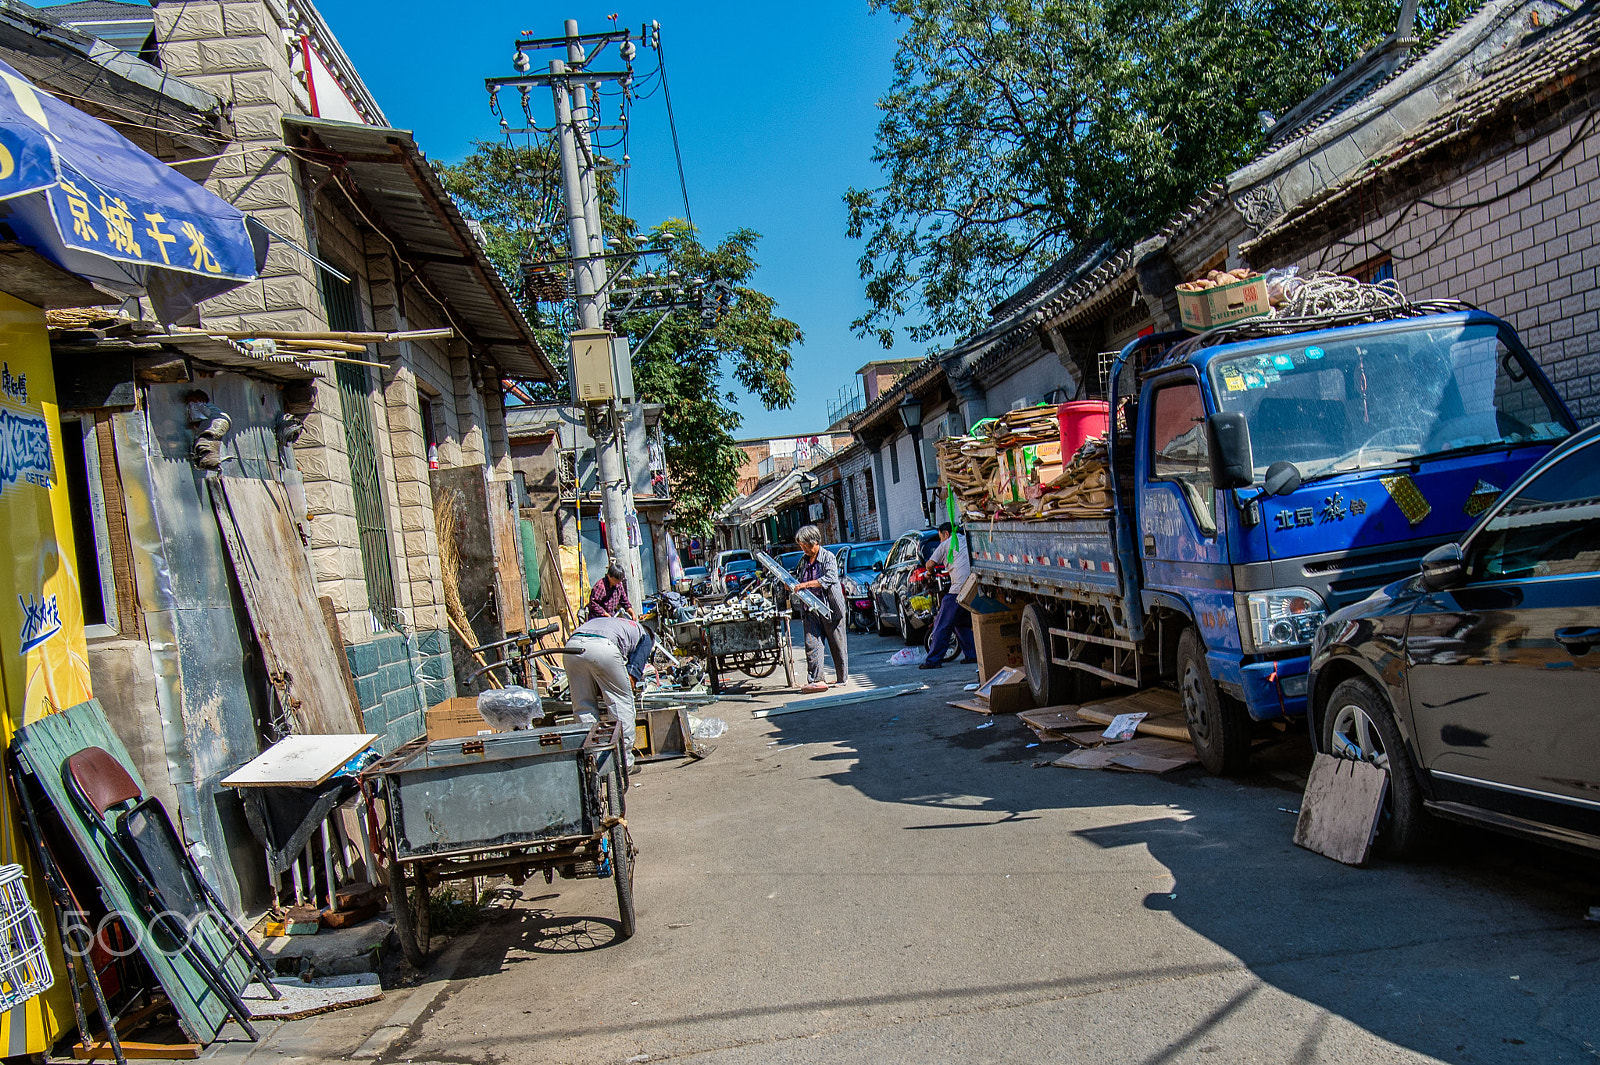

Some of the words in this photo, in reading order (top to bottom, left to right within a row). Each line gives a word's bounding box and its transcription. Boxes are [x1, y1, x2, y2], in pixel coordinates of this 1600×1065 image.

[60, 181, 221, 273] 京城千兆
[1211, 304, 1258, 320] Bananas
